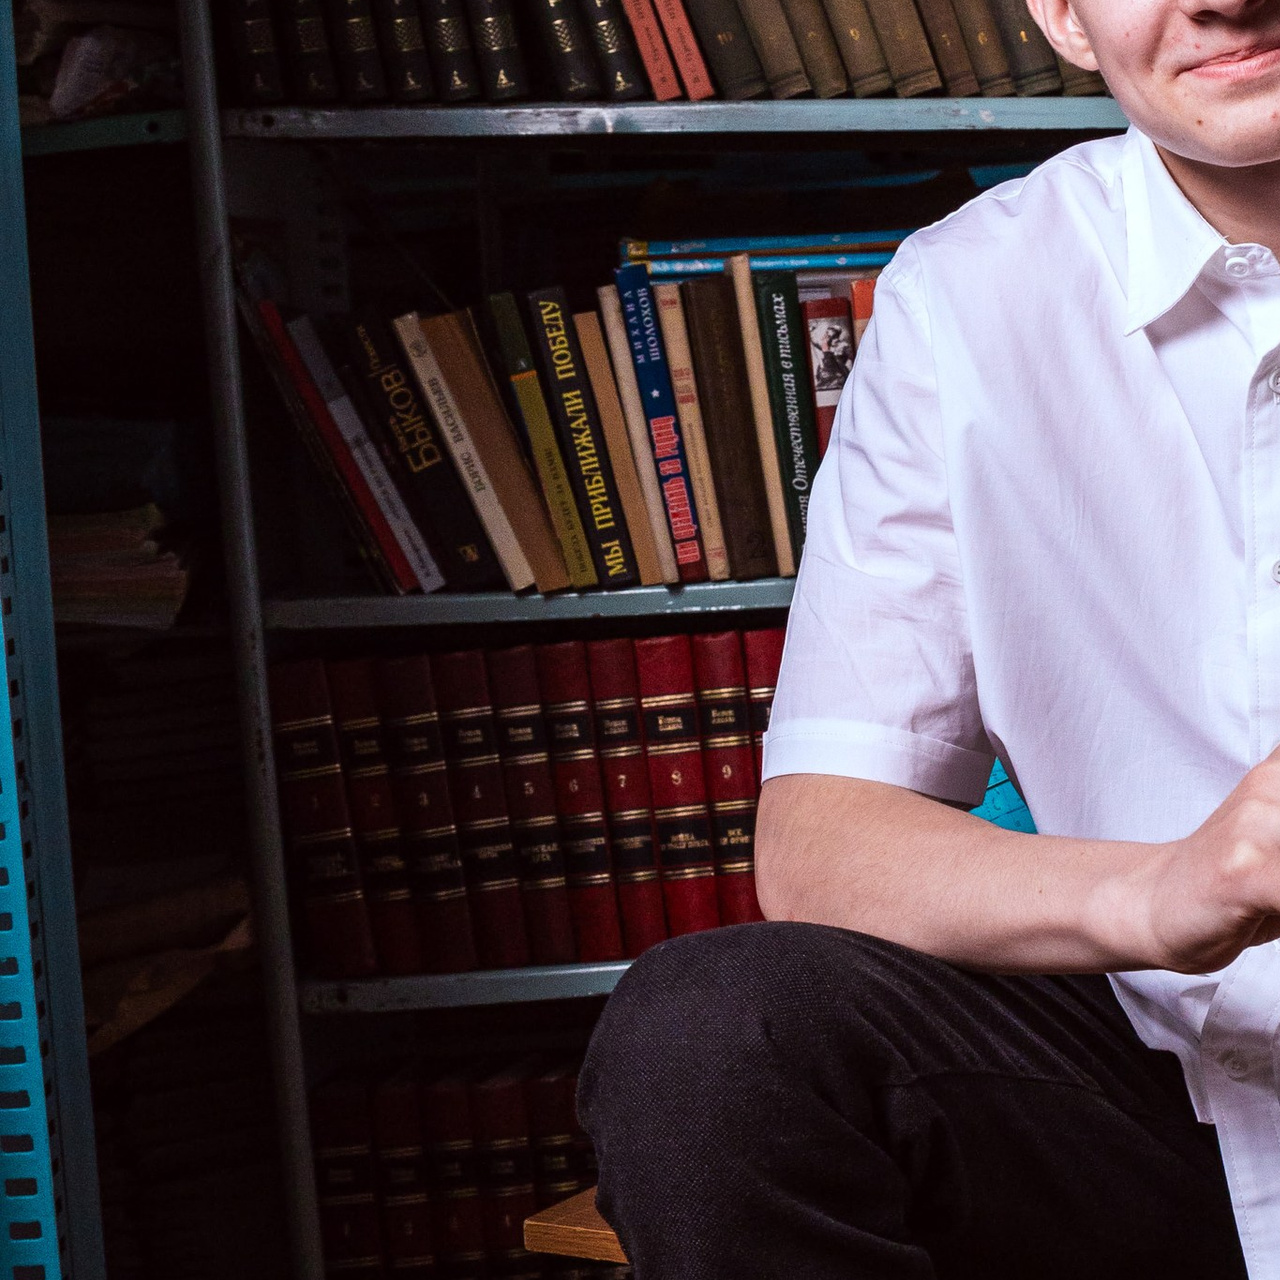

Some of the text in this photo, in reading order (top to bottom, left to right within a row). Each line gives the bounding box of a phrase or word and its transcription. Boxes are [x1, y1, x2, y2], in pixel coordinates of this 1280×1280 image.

[622, 289, 646, 364] МИХАИЛ
[636, 287, 661, 362] ШОЛОХОВ
[769, 293, 809, 490] Отечественная в письмах
[428, 377, 486, 492] БОРИС ВАСИЛЬЕВ
[538, 300, 627, 576] МЫ ПРИБЛИЖАЛИ ПОБЕДУ
[670, 769, 682, 786] 8
[722, 764, 732, 780] 9
[523, 780, 535, 796] 5
[568, 778, 579, 793] 6
[617, 774, 628, 789] 7
[417, 791, 430, 808] 3
[471, 784, 482, 801] 4
